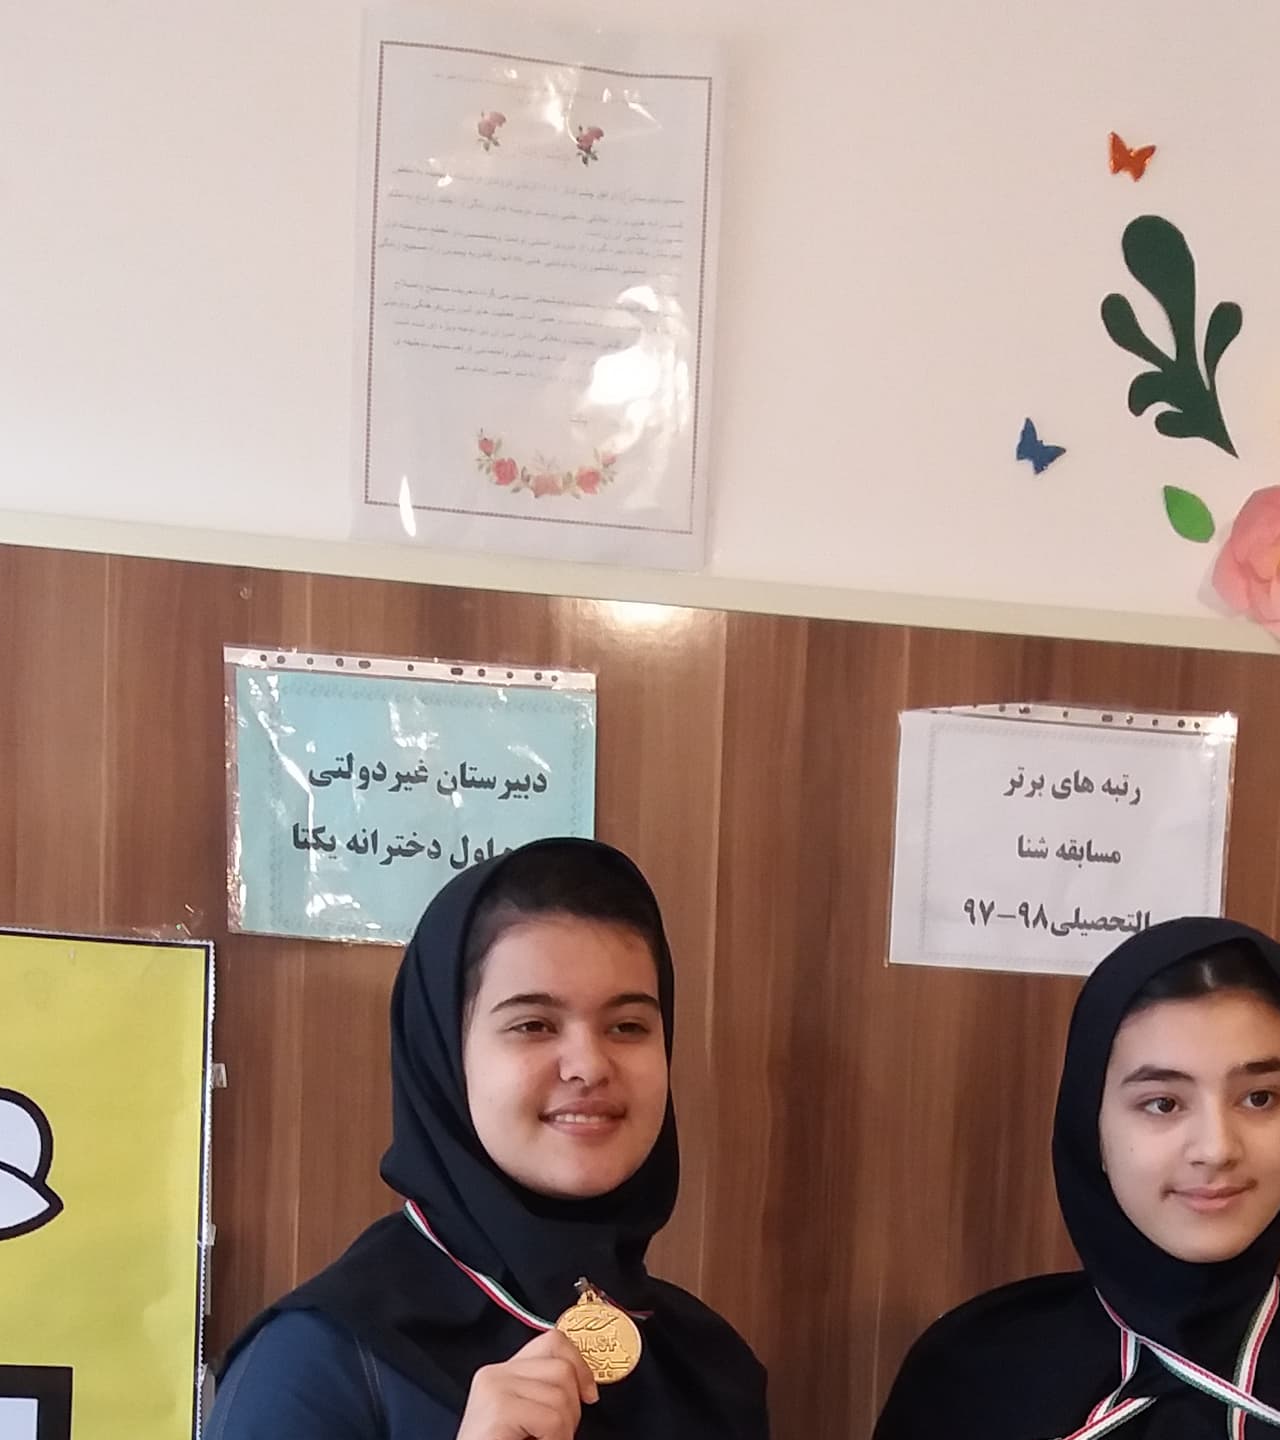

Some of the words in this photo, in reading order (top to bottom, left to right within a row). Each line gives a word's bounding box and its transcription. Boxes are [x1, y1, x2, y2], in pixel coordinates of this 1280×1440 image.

[436, 761, 548, 800] دبیرستان
[1003, 766, 1045, 799] برتر
[1051, 769, 1095, 801] های
[1101, 773, 1142, 806] رتبه
[292, 823, 337, 861] یکتا
[345, 828, 442, 867] دخترانه
[1017, 835, 1050, 861] شنا
[1056, 839, 1122, 870] مسابقه
